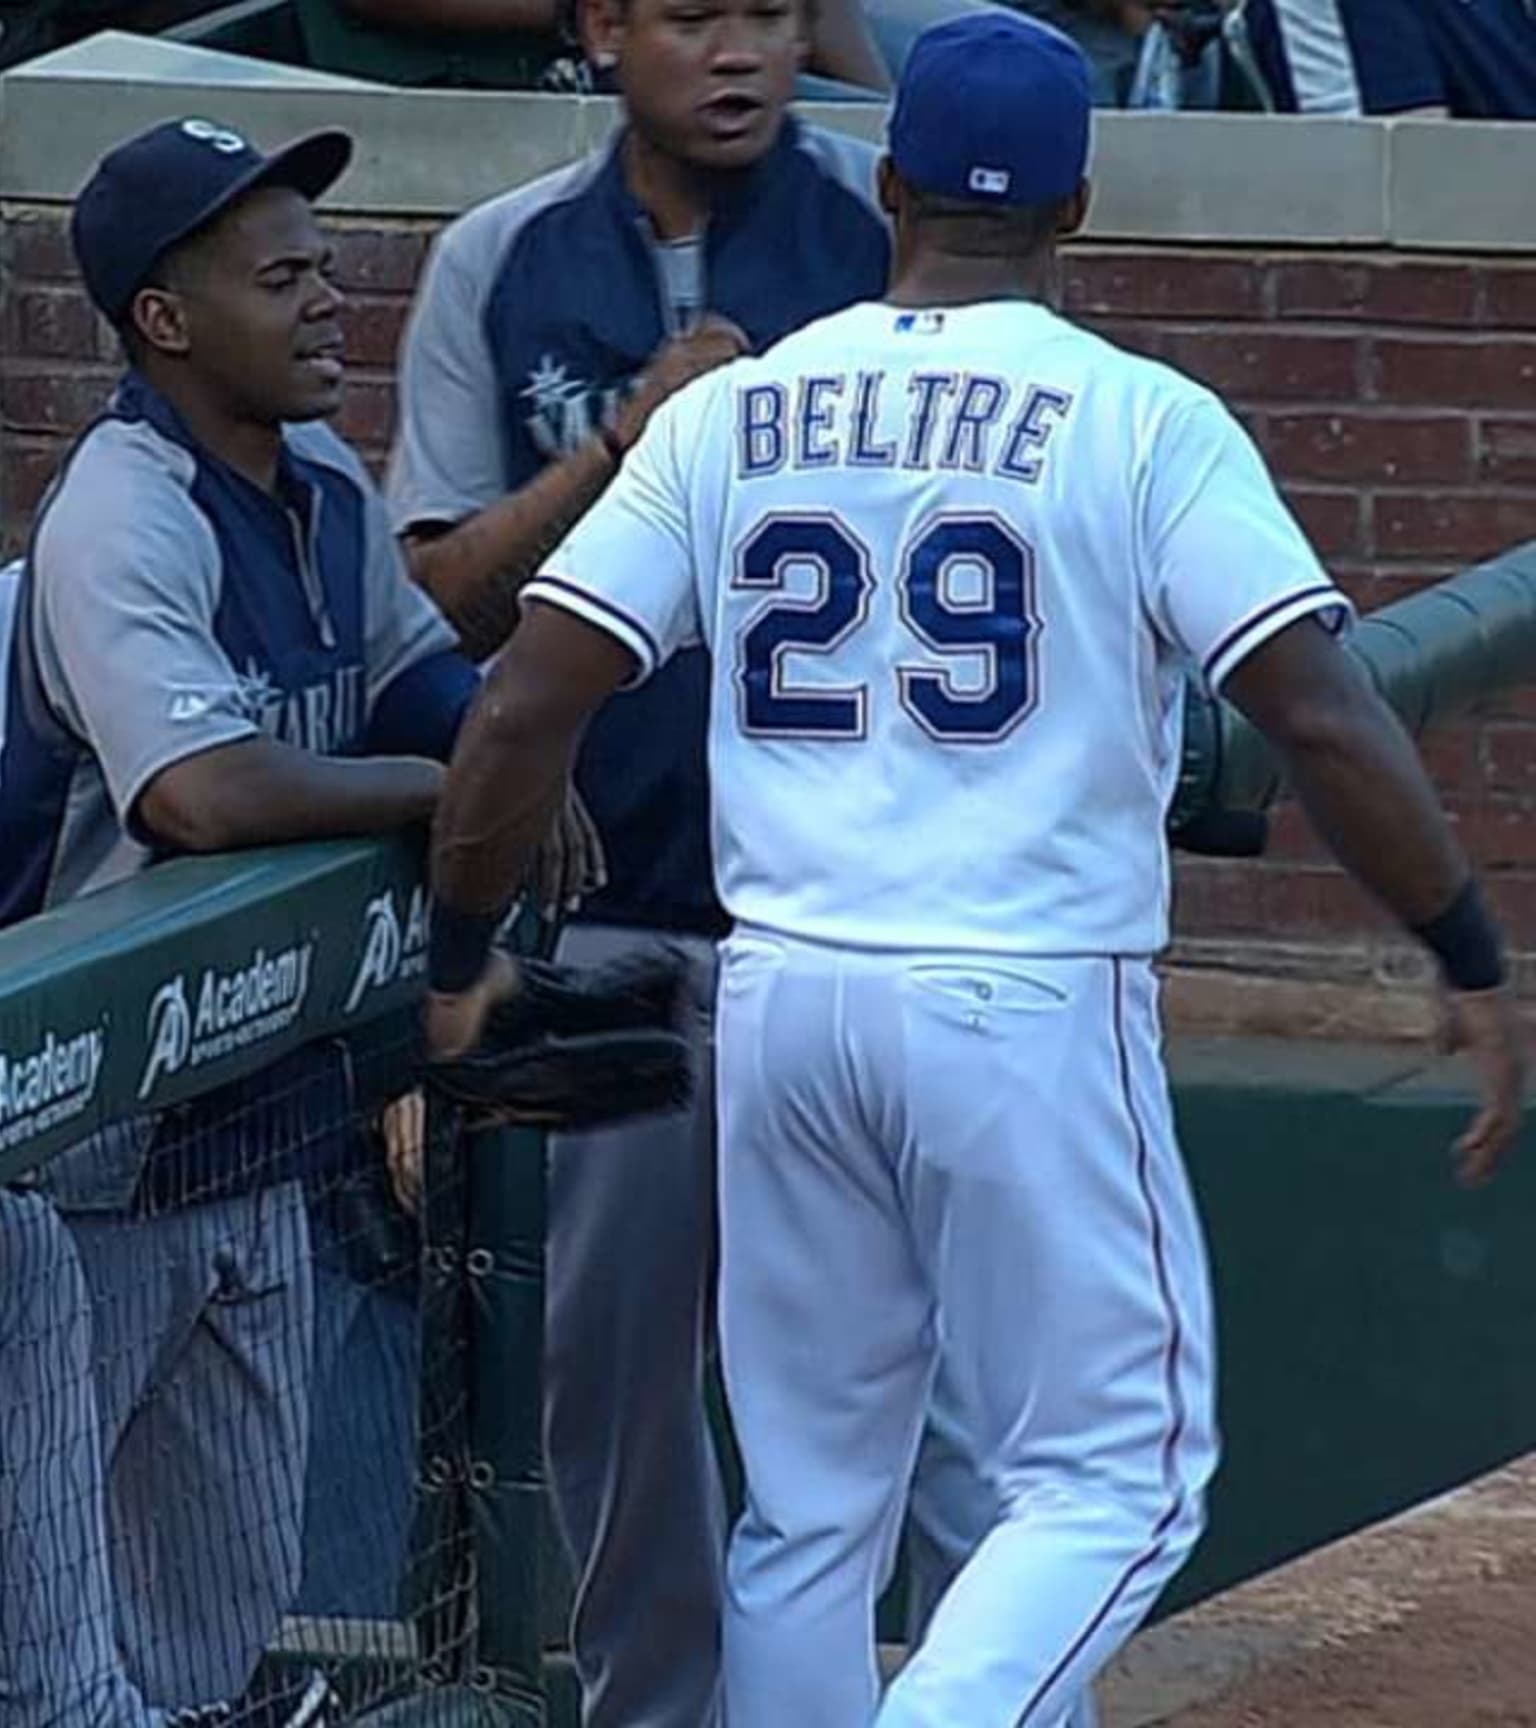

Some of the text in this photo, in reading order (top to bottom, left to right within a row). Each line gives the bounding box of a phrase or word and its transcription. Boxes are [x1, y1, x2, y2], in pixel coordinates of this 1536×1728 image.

[734, 371, 1072, 485] BELTRE
[730, 511, 1044, 745] 29
[194, 943, 312, 1039] Academy
